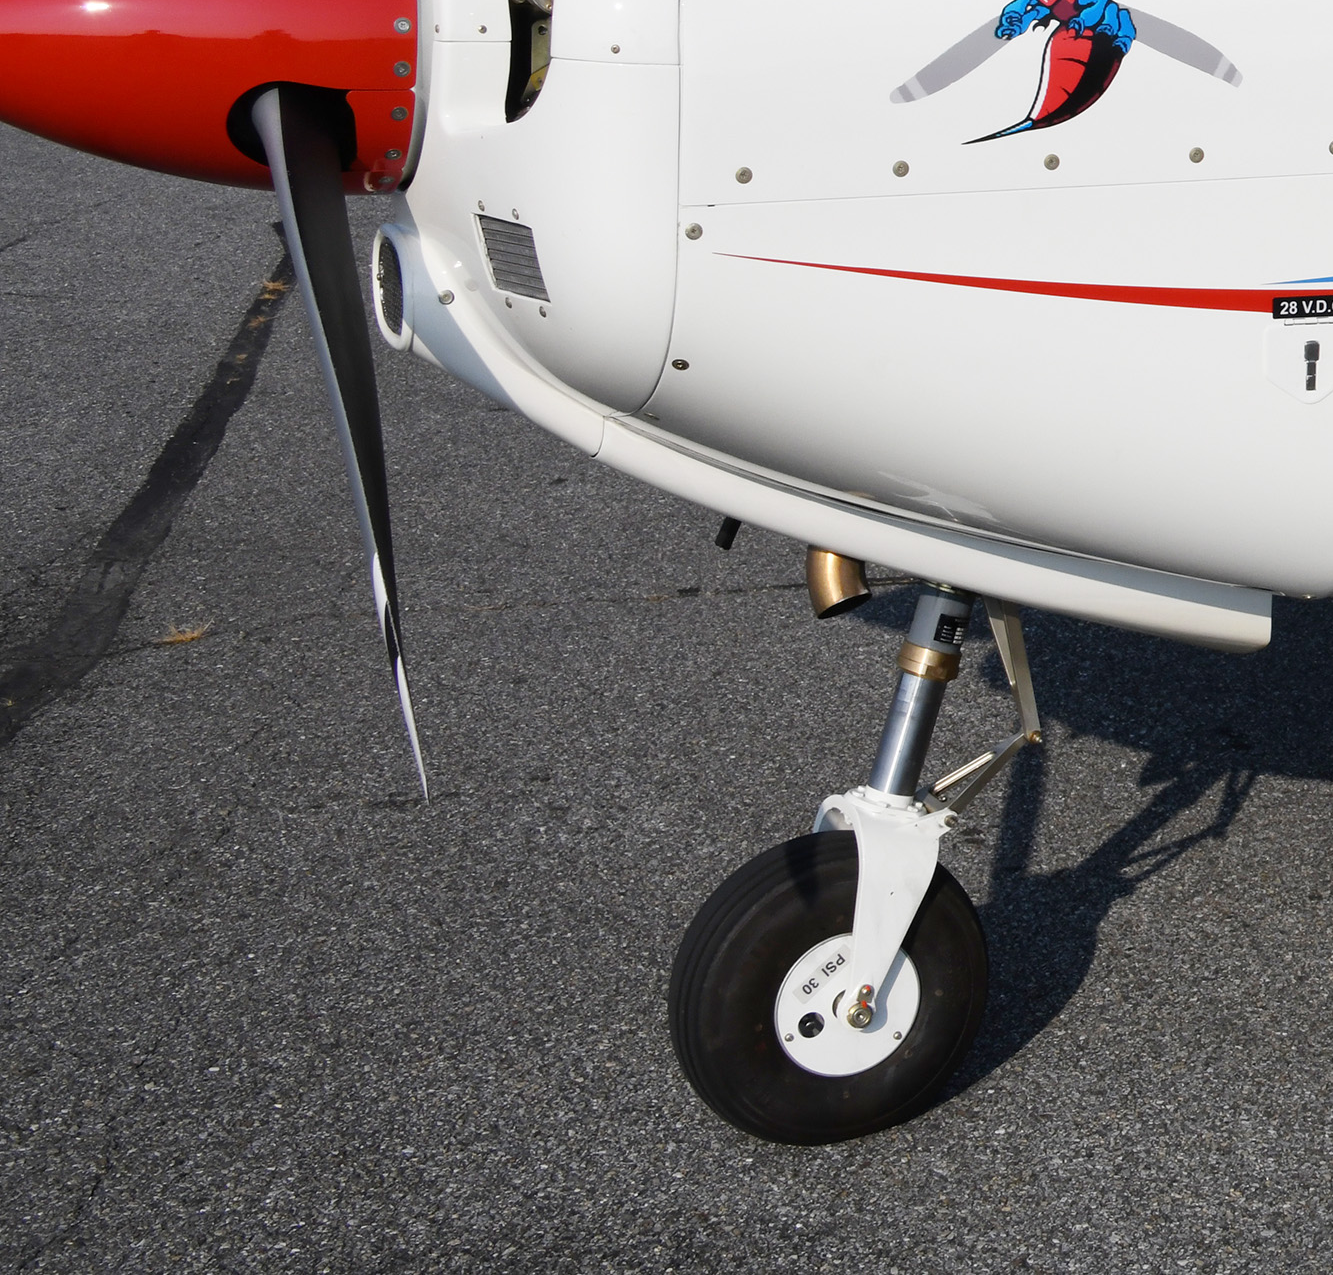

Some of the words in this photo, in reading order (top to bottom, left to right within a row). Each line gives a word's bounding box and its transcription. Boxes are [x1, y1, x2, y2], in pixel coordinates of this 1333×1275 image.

[1280, 301, 1298, 315] 28
[821, 953, 846, 977] PSI
[802, 977, 819, 995] 30
